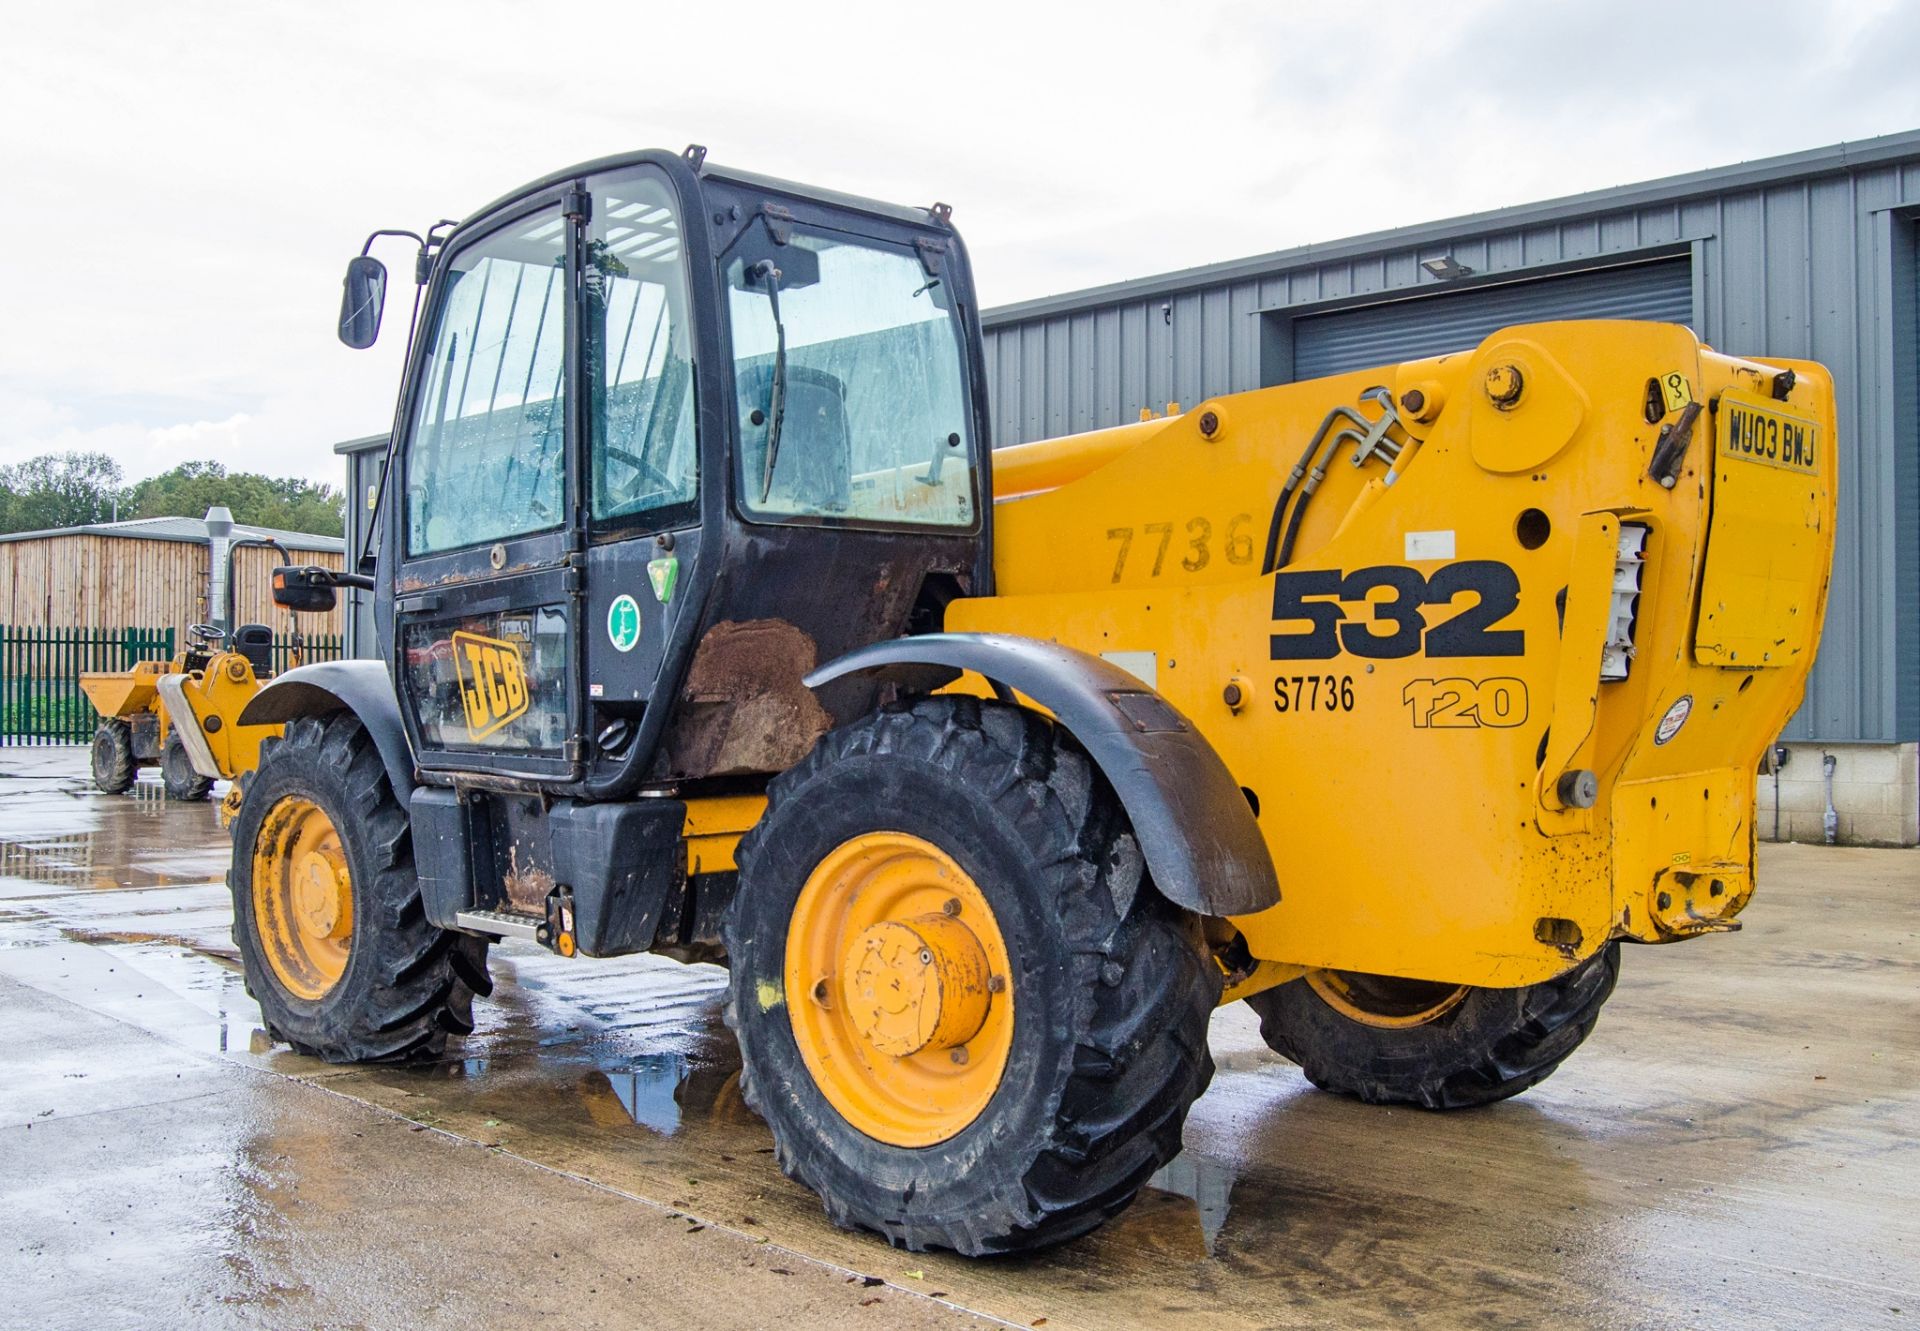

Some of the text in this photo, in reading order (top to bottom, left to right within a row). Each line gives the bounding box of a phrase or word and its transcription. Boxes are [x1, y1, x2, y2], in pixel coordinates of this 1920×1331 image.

[1730, 409, 1815, 467] WU03 BWJ
[1107, 513, 1253, 584] 7736
[1270, 560, 1525, 660] 532
[465, 642, 524, 729] JCB
[1274, 675, 1354, 712] S7736
[1403, 677, 1528, 728] 120
